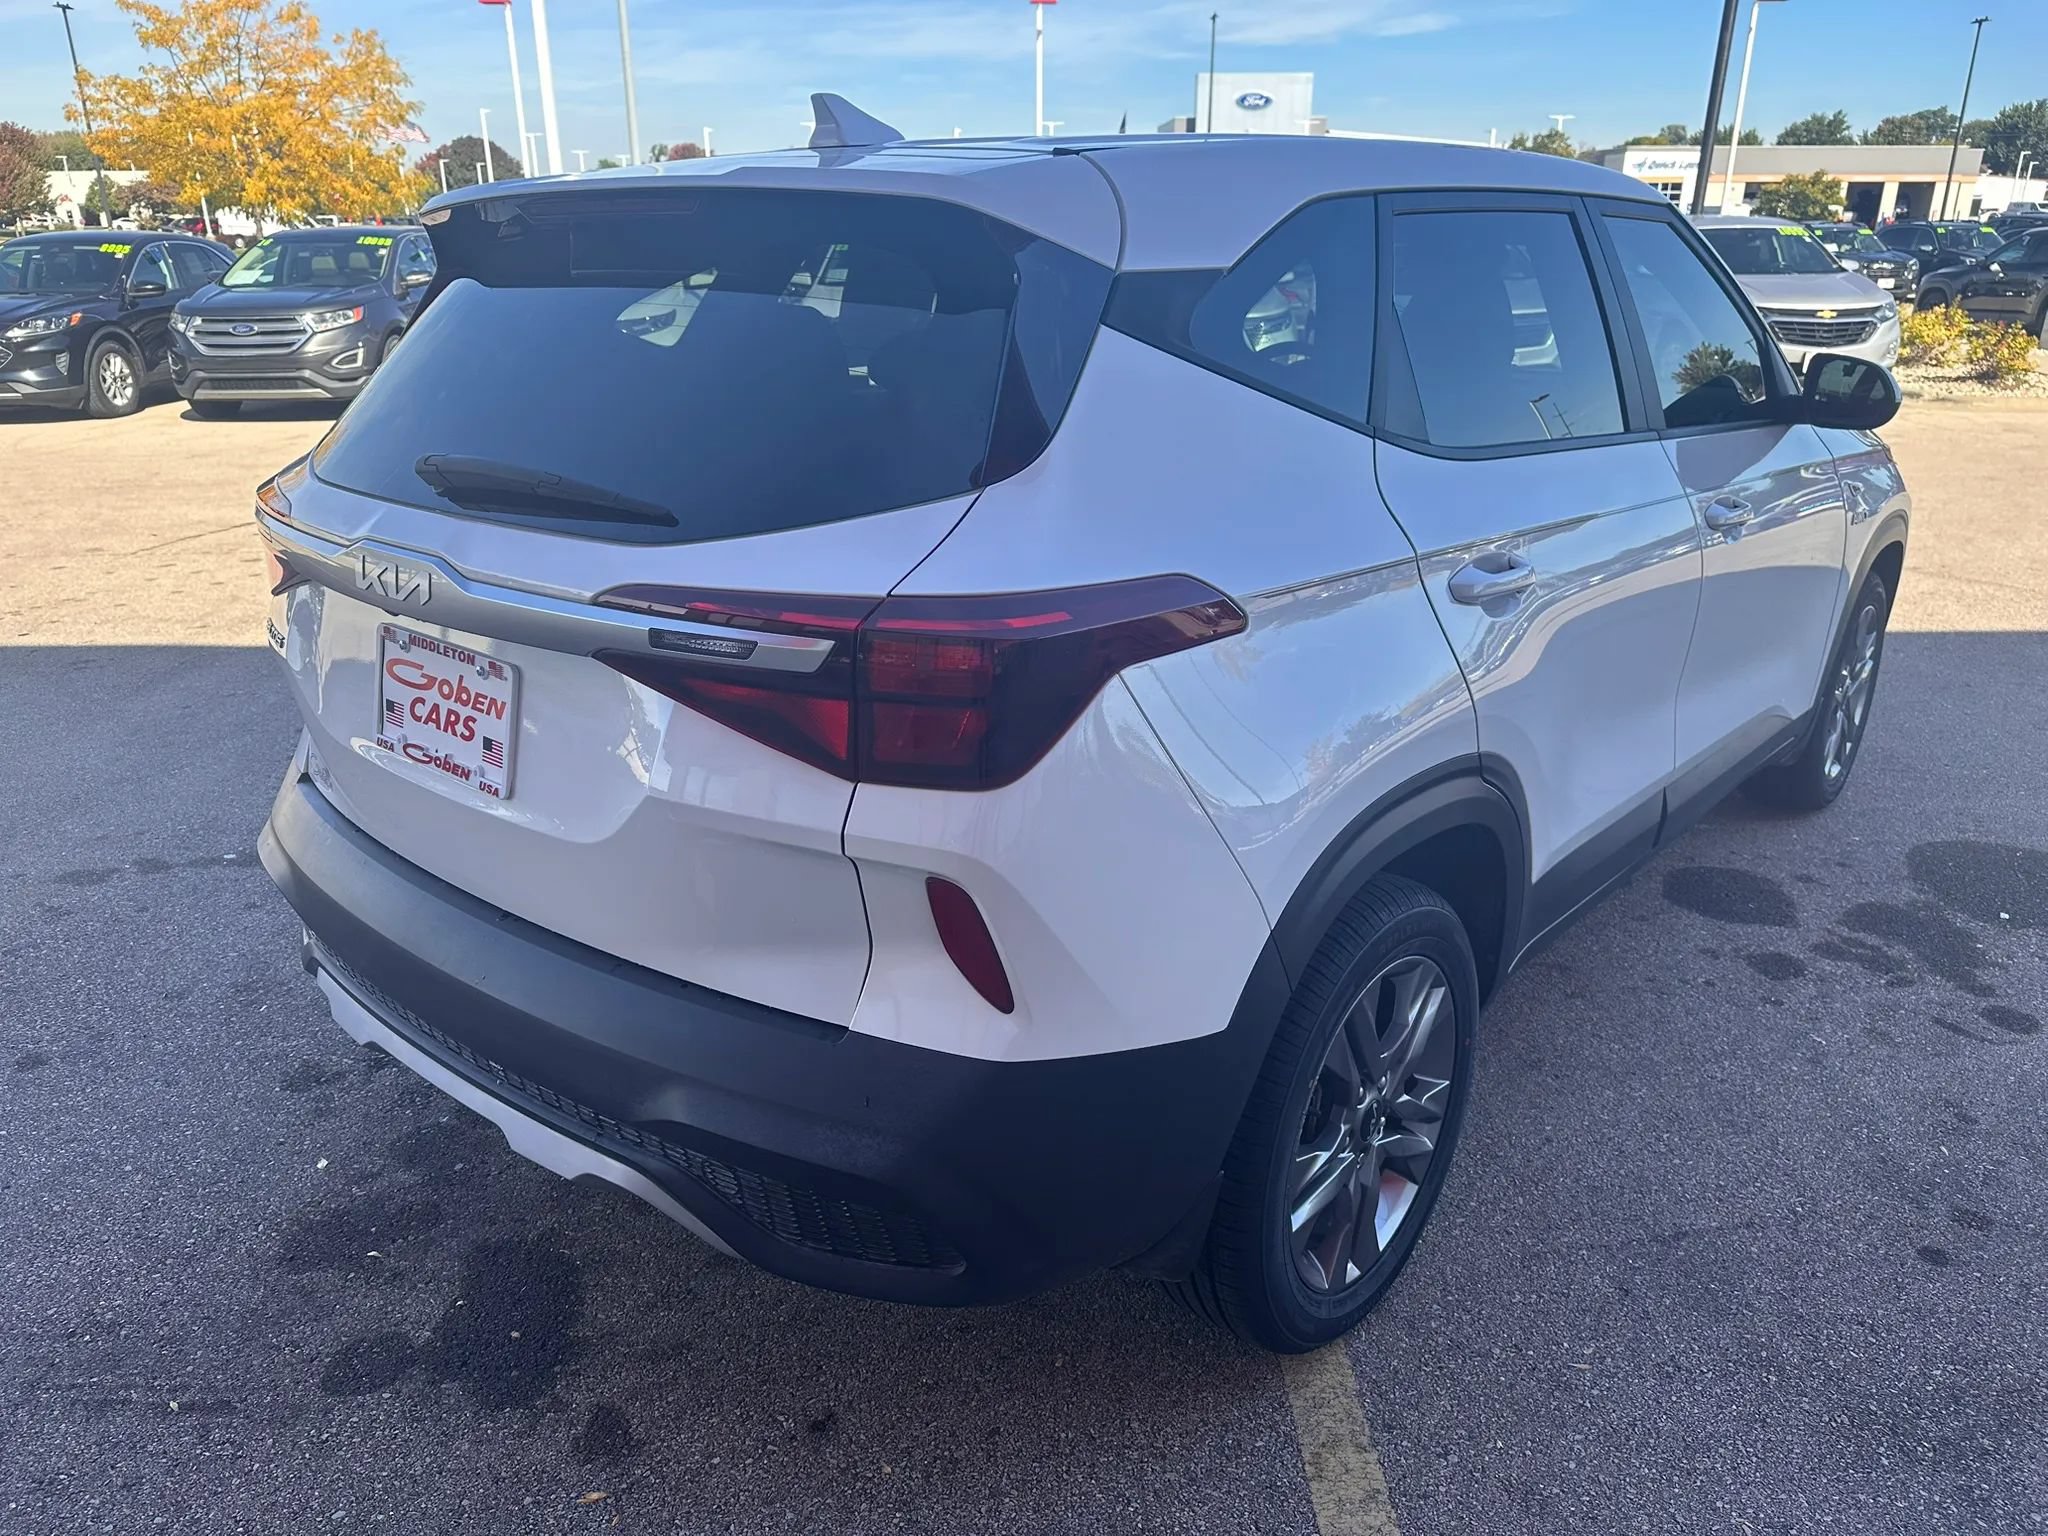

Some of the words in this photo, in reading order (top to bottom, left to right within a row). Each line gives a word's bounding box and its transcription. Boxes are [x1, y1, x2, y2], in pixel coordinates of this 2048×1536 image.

[355, 554, 431, 607] KIA
[408, 633, 476, 667] MIDDLETON
[409, 696, 478, 742] CARS
[376, 736, 395, 753] USA
[478, 780, 500, 798] USA
